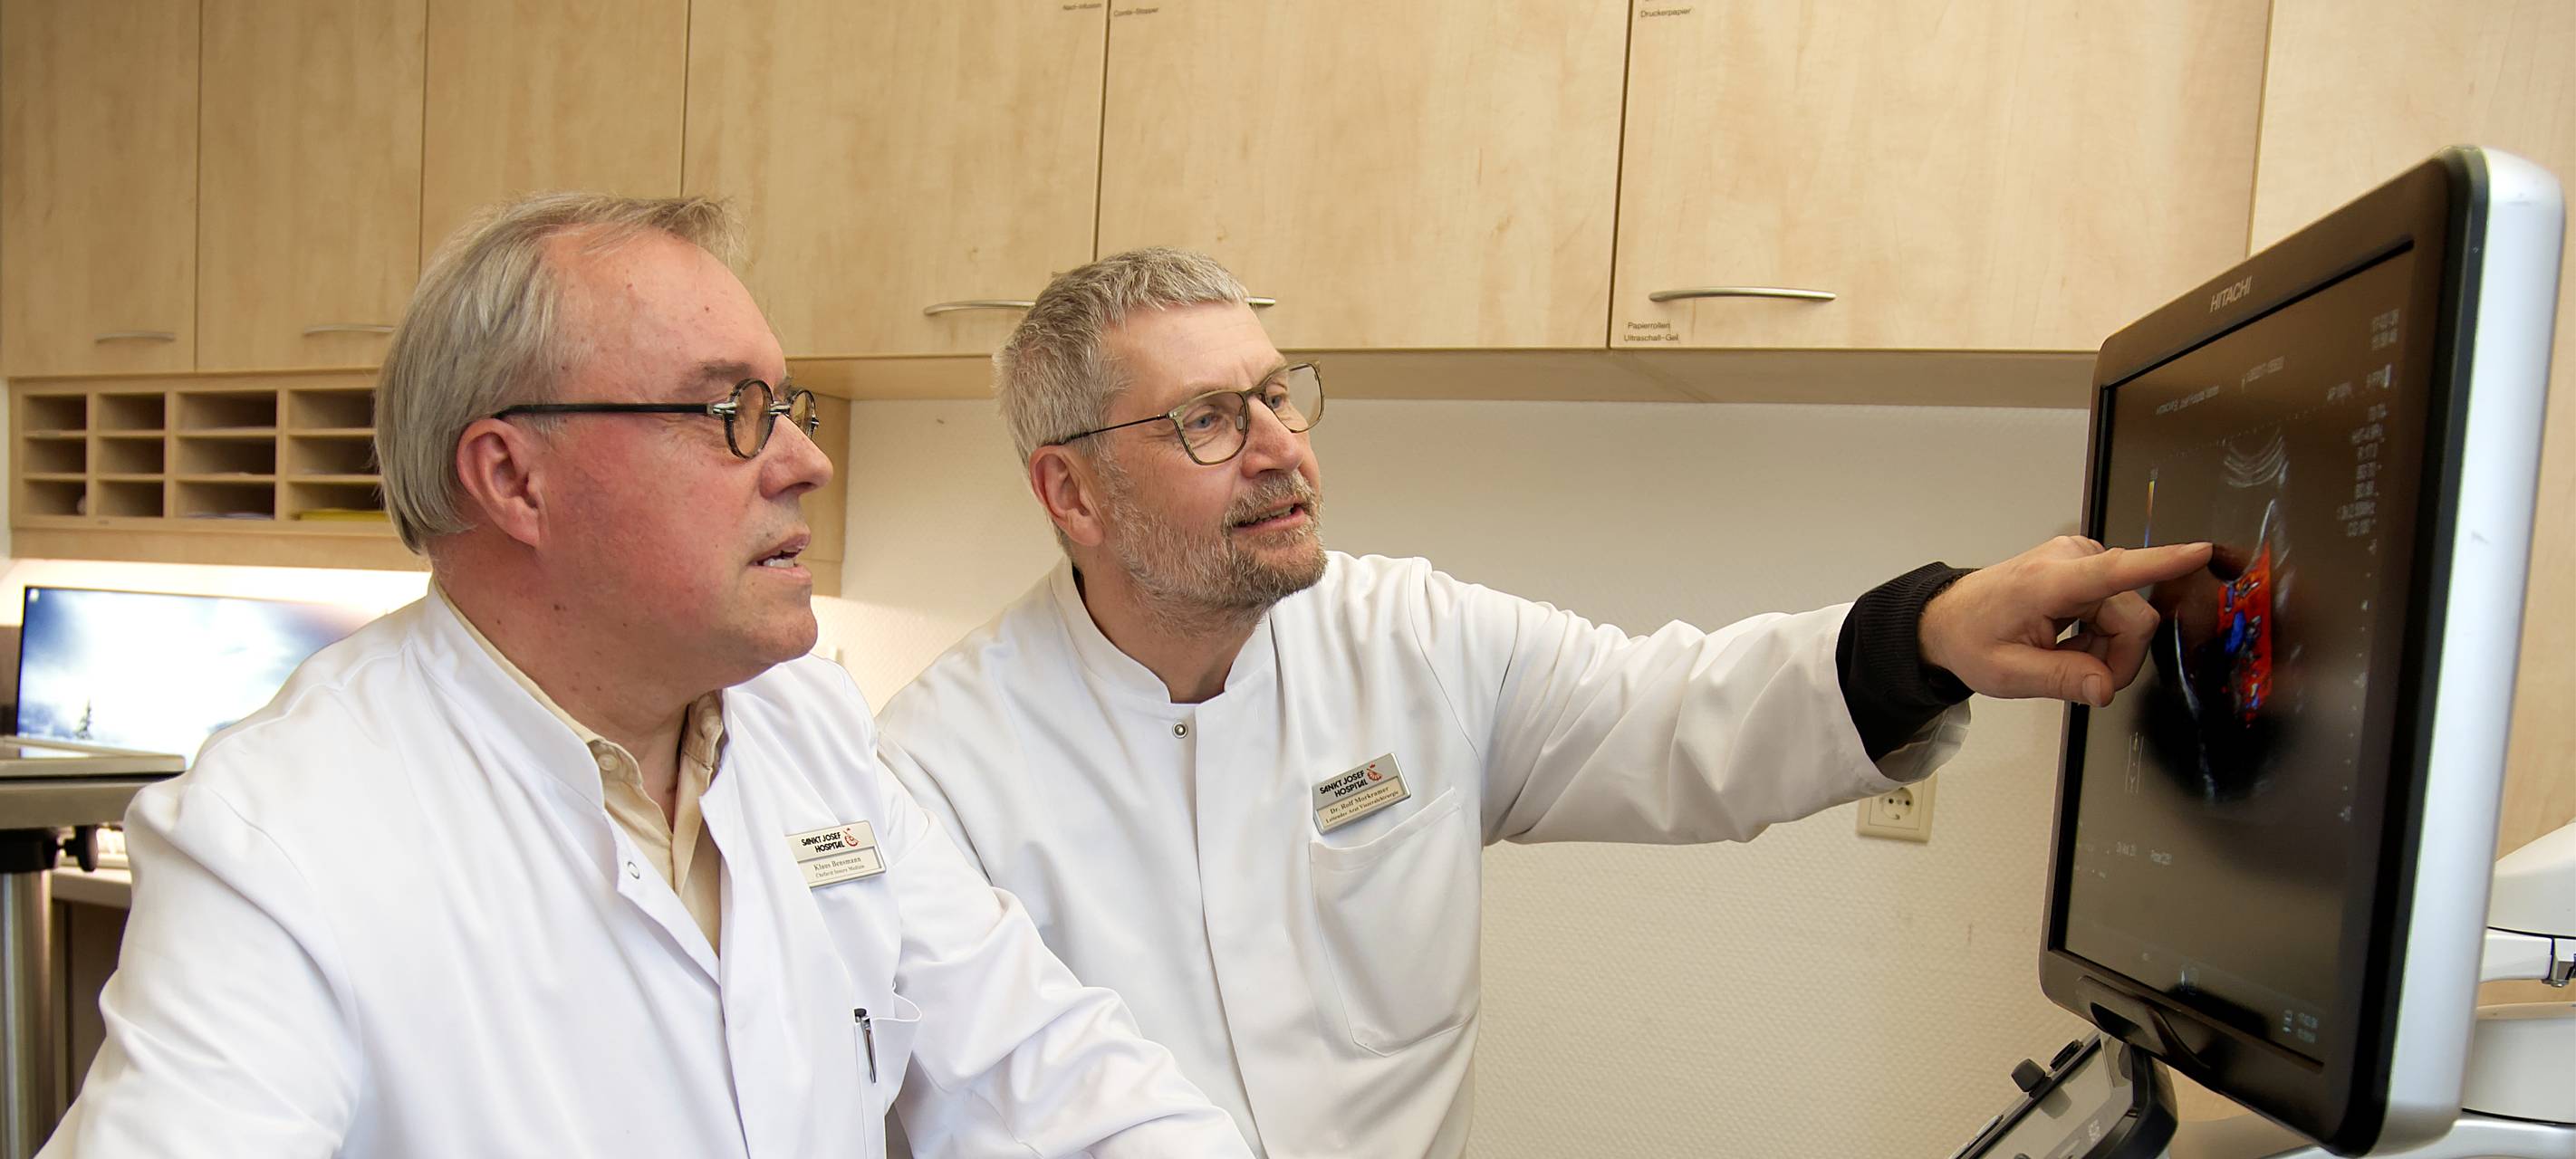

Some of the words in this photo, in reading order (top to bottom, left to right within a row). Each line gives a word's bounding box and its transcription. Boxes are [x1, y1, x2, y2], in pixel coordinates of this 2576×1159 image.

[1640, 8, 1692, 18] Druckerpapier
[2210, 275, 2254, 313] HITACHI
[1320, 780, 1342, 795] SANKT
[1343, 770, 1365, 785] JOSEF
[1334, 779, 1369, 798] HOSPITAL
[1341, 800, 1354, 810] Rolf
[801, 836, 822, 847] SANKT
[822, 831, 841, 842] JOSEF
[815, 840, 845, 853] HOSPITAL
